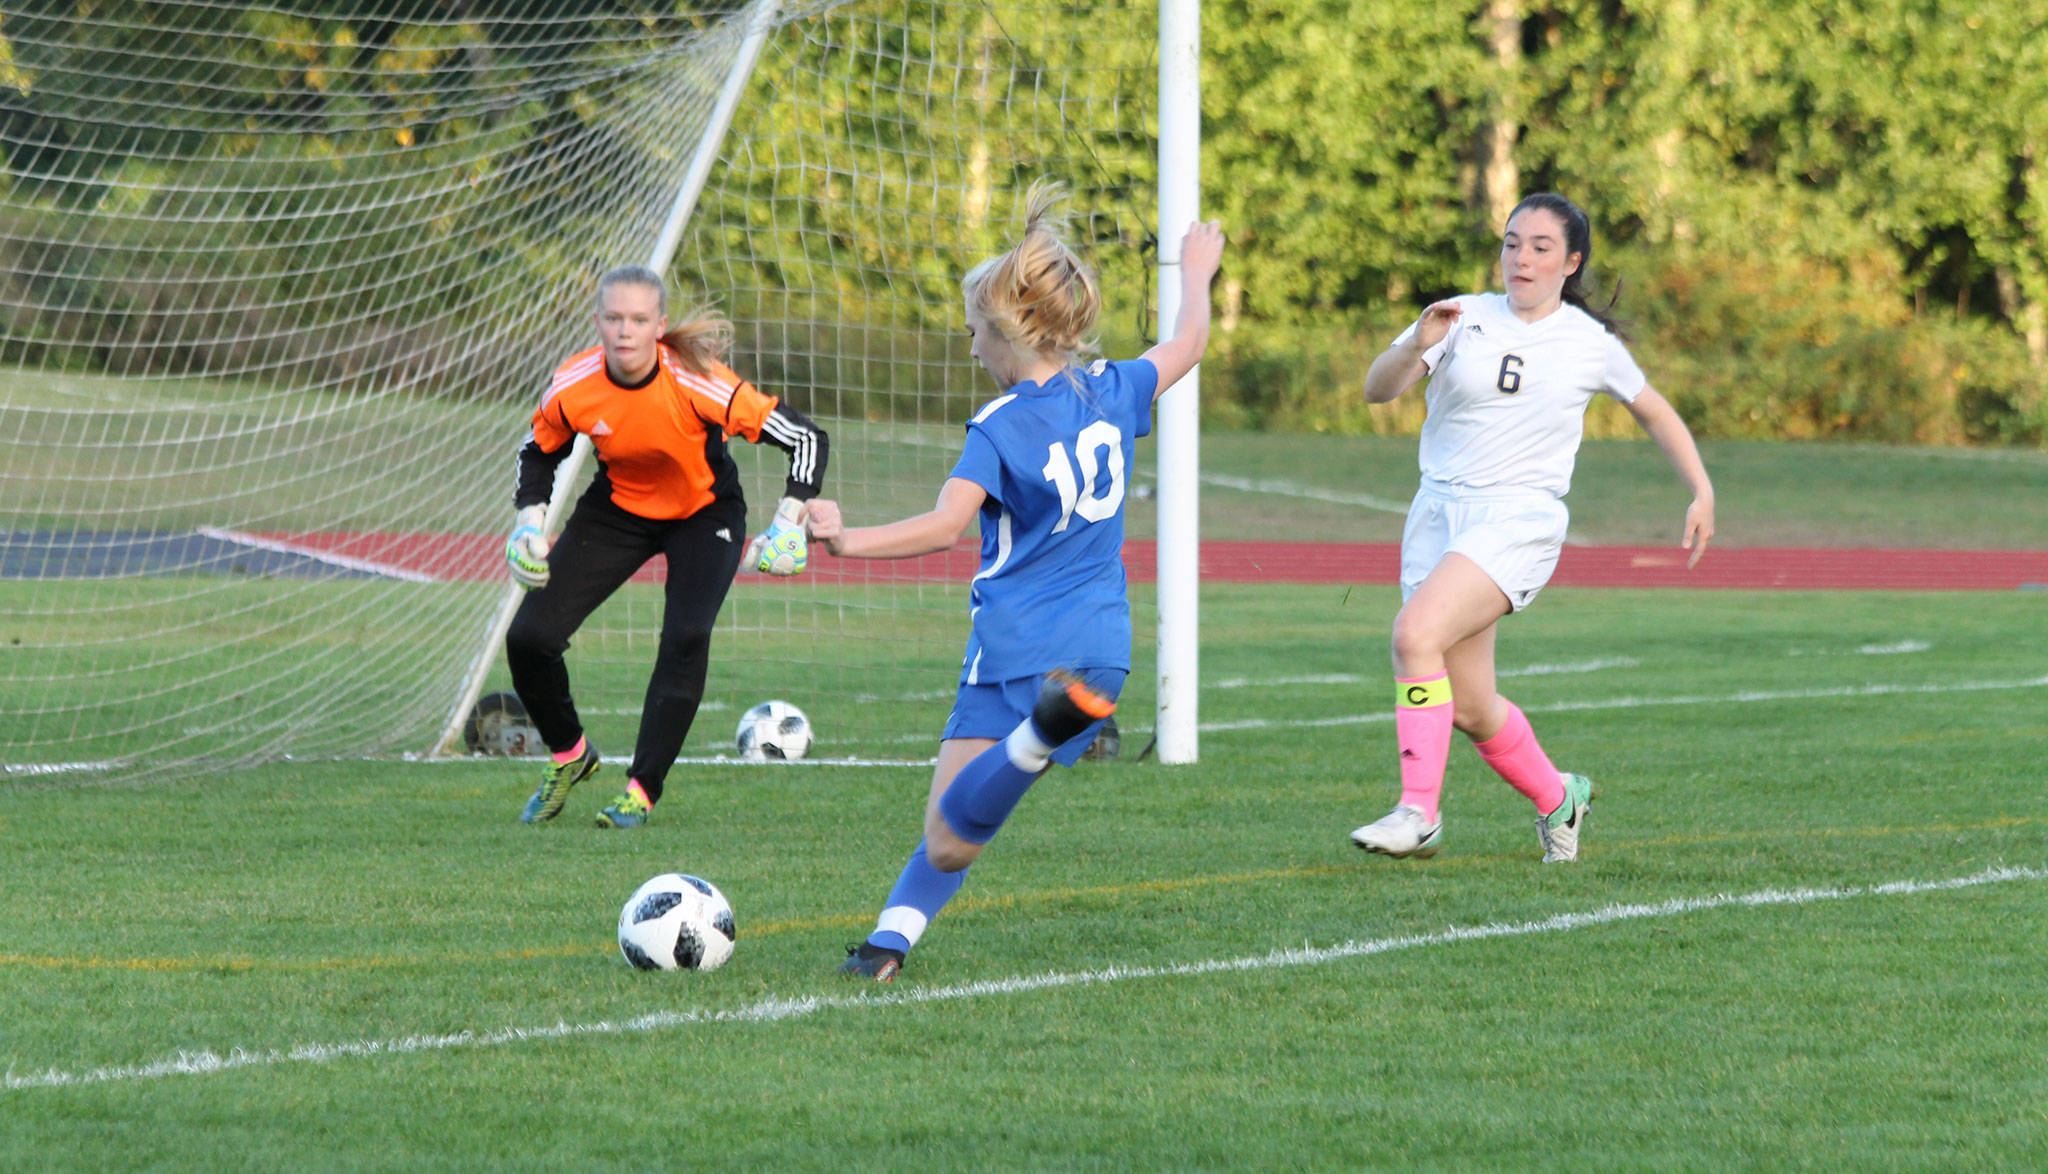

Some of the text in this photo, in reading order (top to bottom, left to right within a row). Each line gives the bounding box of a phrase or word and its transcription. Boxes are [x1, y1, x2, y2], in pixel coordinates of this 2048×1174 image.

[1496, 353, 1524, 395] 6
[1042, 419, 1125, 534] 10
[1407, 686, 1429, 705] C
